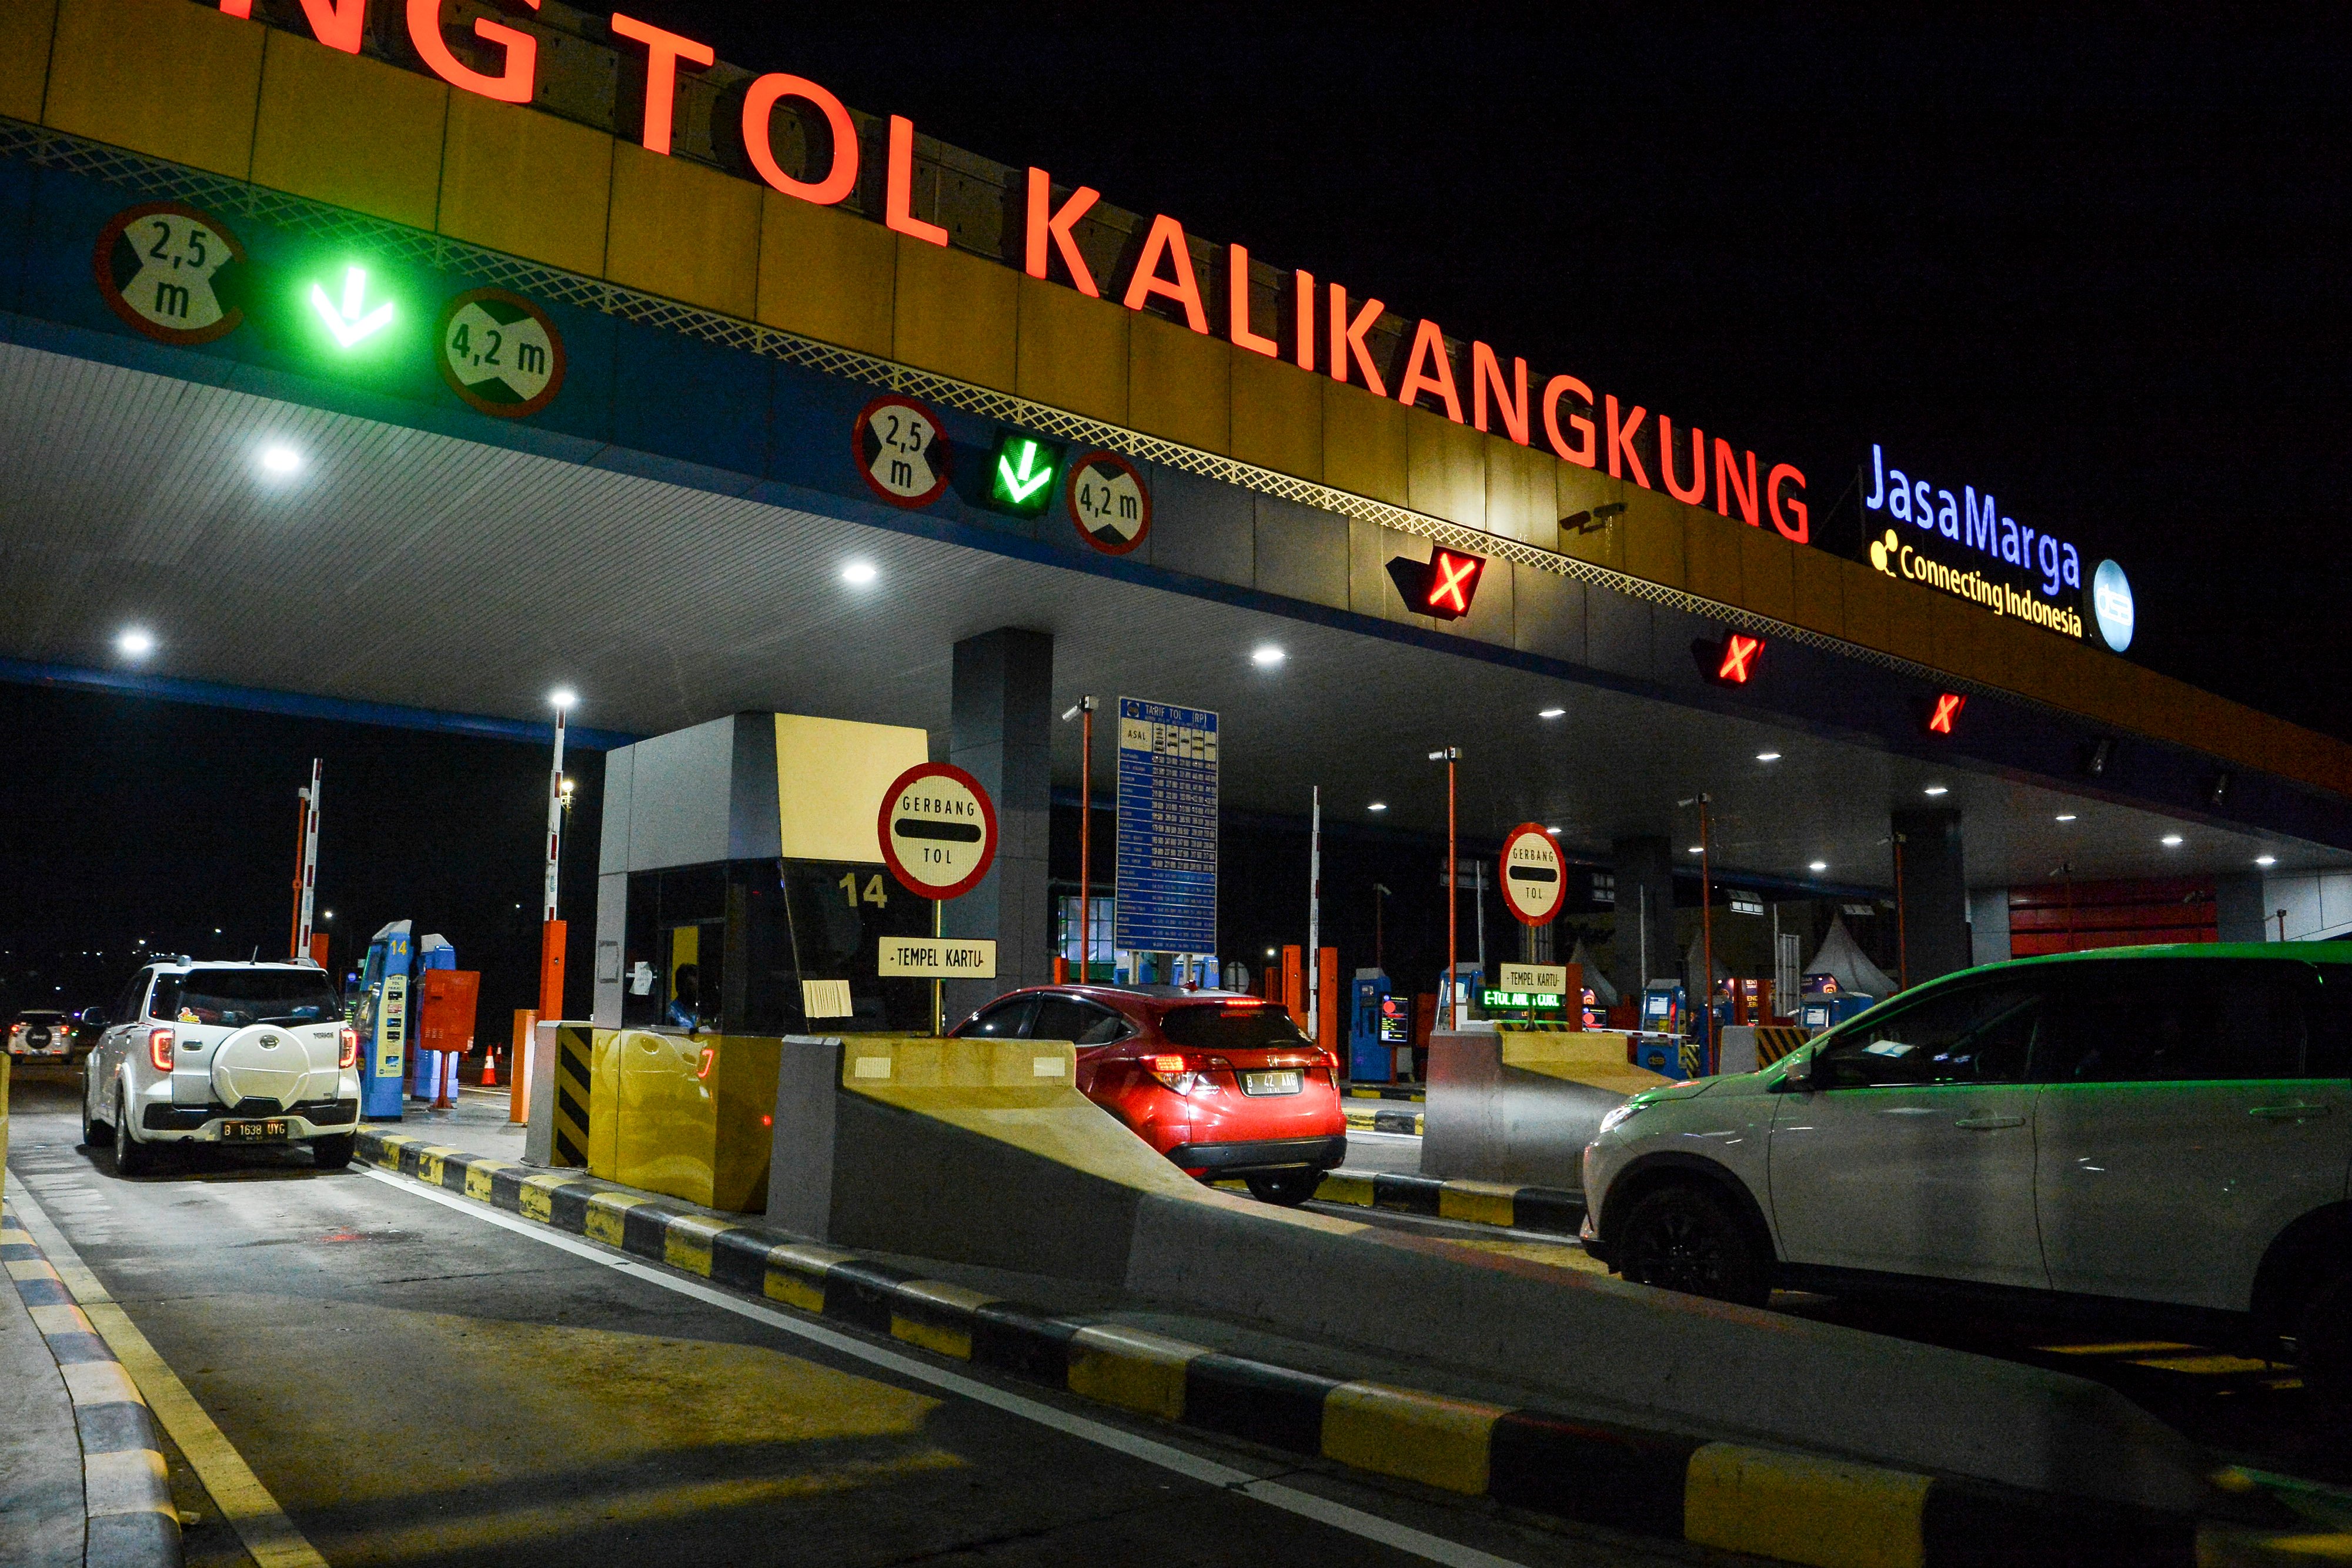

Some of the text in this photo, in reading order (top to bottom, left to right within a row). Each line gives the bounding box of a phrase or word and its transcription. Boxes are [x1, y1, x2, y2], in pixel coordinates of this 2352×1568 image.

[149, 221, 207, 269] 2,5
[612, 13, 948, 248] TOL
[1025, 167, 1809, 544] KALIKANGKUNG
[155, 284, 189, 318] m
[452, 324, 546, 375] 4,2 m
[886, 415, 922, 453] 2,5
[891, 459, 913, 488] m
[1080, 484, 1138, 520] 4,2 m
[1900, 545, 2003, 616] Connecting
[2004, 583, 2082, 638] Indonesia
[1145, 705, 1165, 717] TARIF
[1170, 708, 1182, 720] TOL
[1128, 730, 1146, 740] ASAL
[903, 796, 974, 816] GERBANG
[924, 848, 953, 864] TOL
[1513, 848, 1554, 862] GERBANG
[839, 872, 888, 908] 14
[1525, 887, 1542, 900] TOL
[391, 940, 407, 955] 14
[897, 947, 982, 968] TEMPEL KARTU
[1511, 972, 1557, 987] TEMPEL KARTU
[1247, 1074, 1297, 1088] B 42 AAG
[225, 1124, 285, 1136] B 1638 UYG
